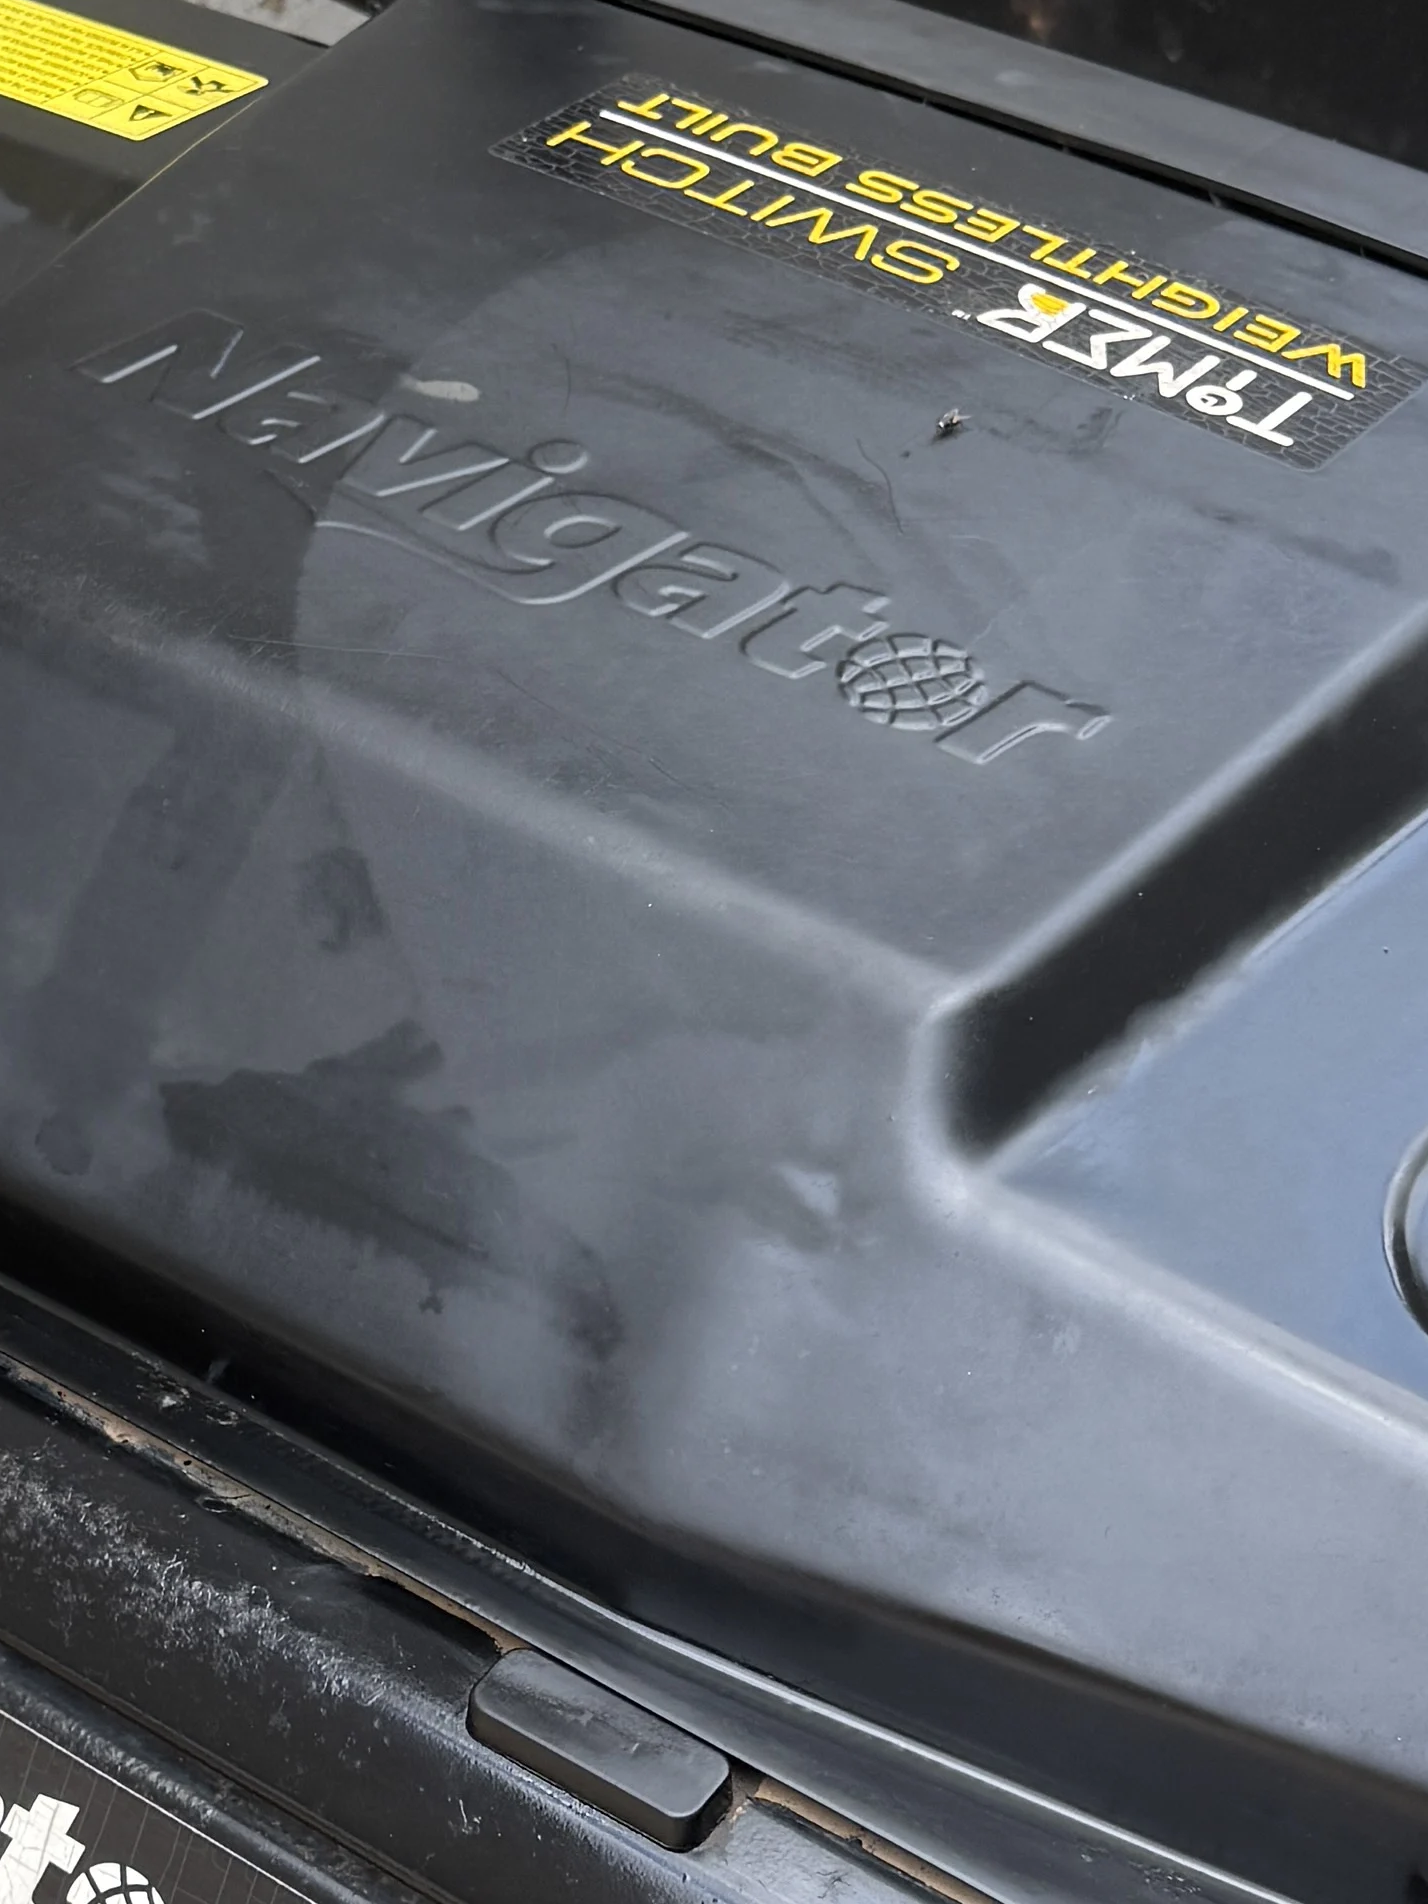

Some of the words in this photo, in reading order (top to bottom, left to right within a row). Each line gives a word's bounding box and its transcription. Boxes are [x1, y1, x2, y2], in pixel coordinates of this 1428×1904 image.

[545, 121, 961, 285] SWITCH
[616, 92, 843, 178] BUILT
[844, 169, 1367, 389] WEIGHTLESS
[66, 308, 1113, 765] Navigator
